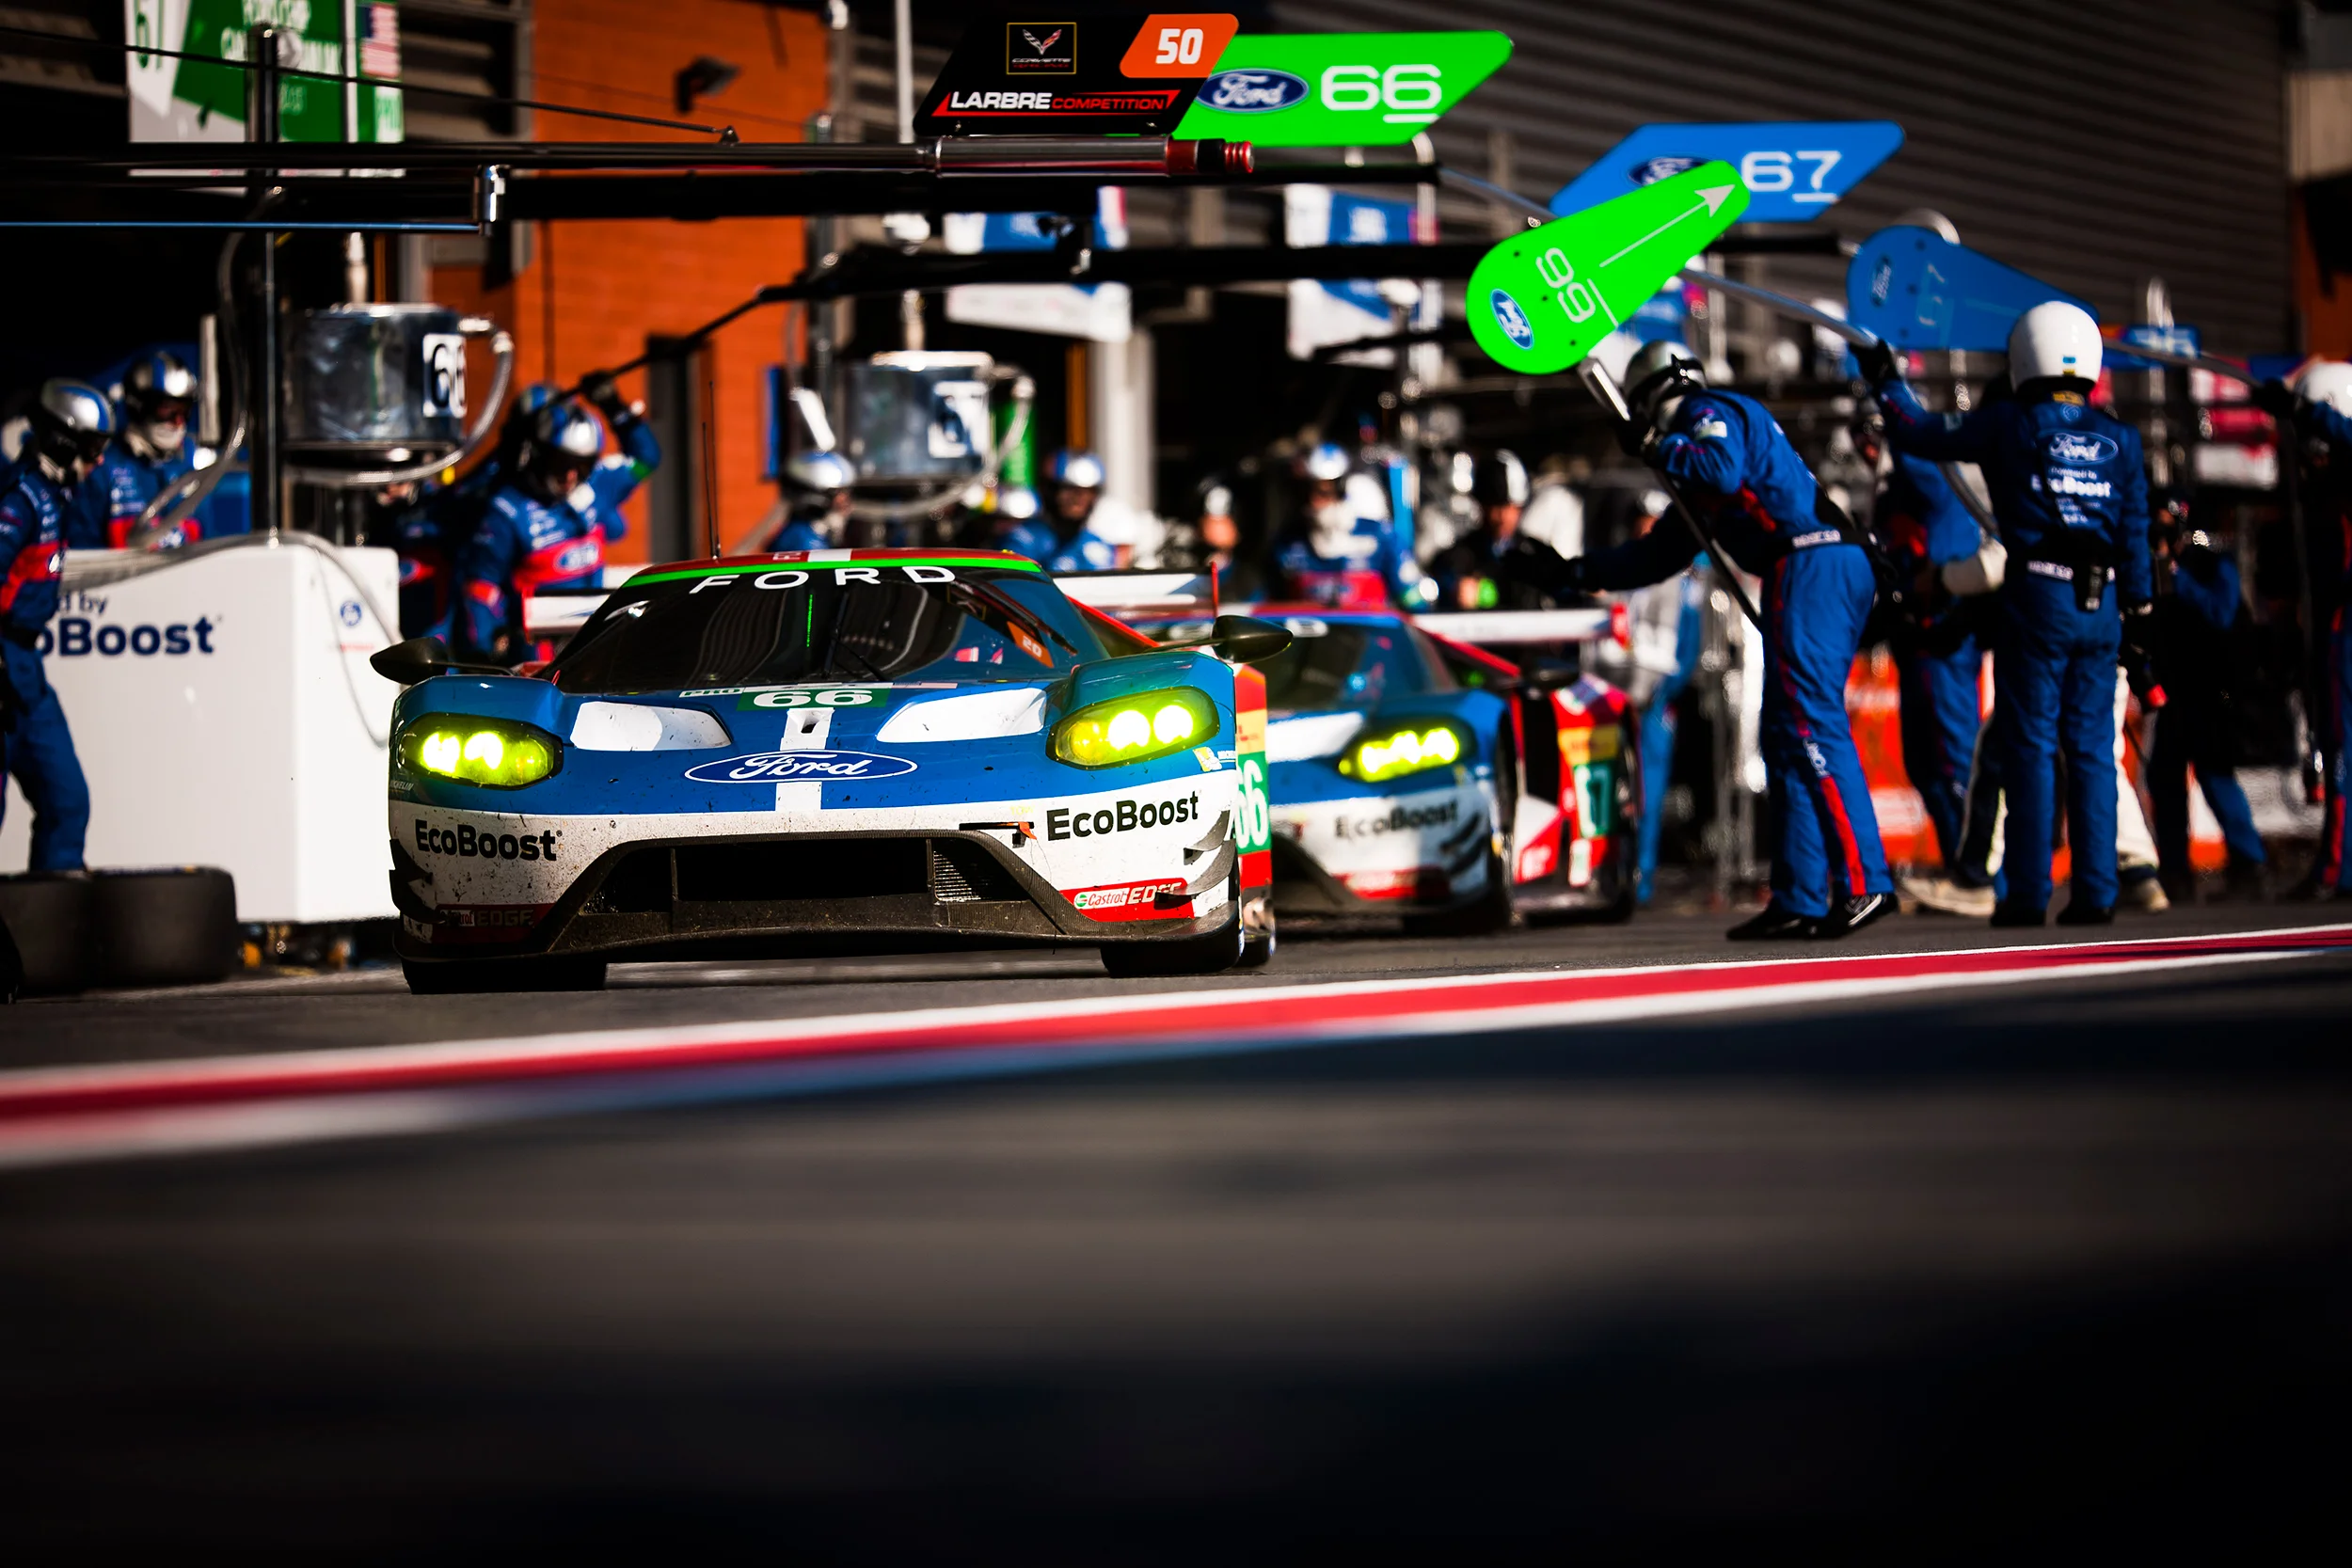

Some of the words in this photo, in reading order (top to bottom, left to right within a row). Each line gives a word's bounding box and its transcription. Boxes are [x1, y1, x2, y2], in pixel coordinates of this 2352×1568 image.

[1155, 28, 1203, 64] 50
[950, 91, 1053, 110] LARBRE
[1052, 98, 1165, 110] COMPETITION
[1213, 73, 1287, 106] Ford
[1321, 64, 1442, 111] 66
[1741, 150, 1841, 192] 67
[689, 566, 956, 594] FORD
[754, 689, 873, 707] 66
[729, 753, 873, 779] Ford
[1046, 791, 1199, 842] EcoBoost
[1334, 799, 1457, 838] EcoBoost
[415, 819, 557, 862] EcoBoost
[1088, 891, 1126, 906] Castrol
